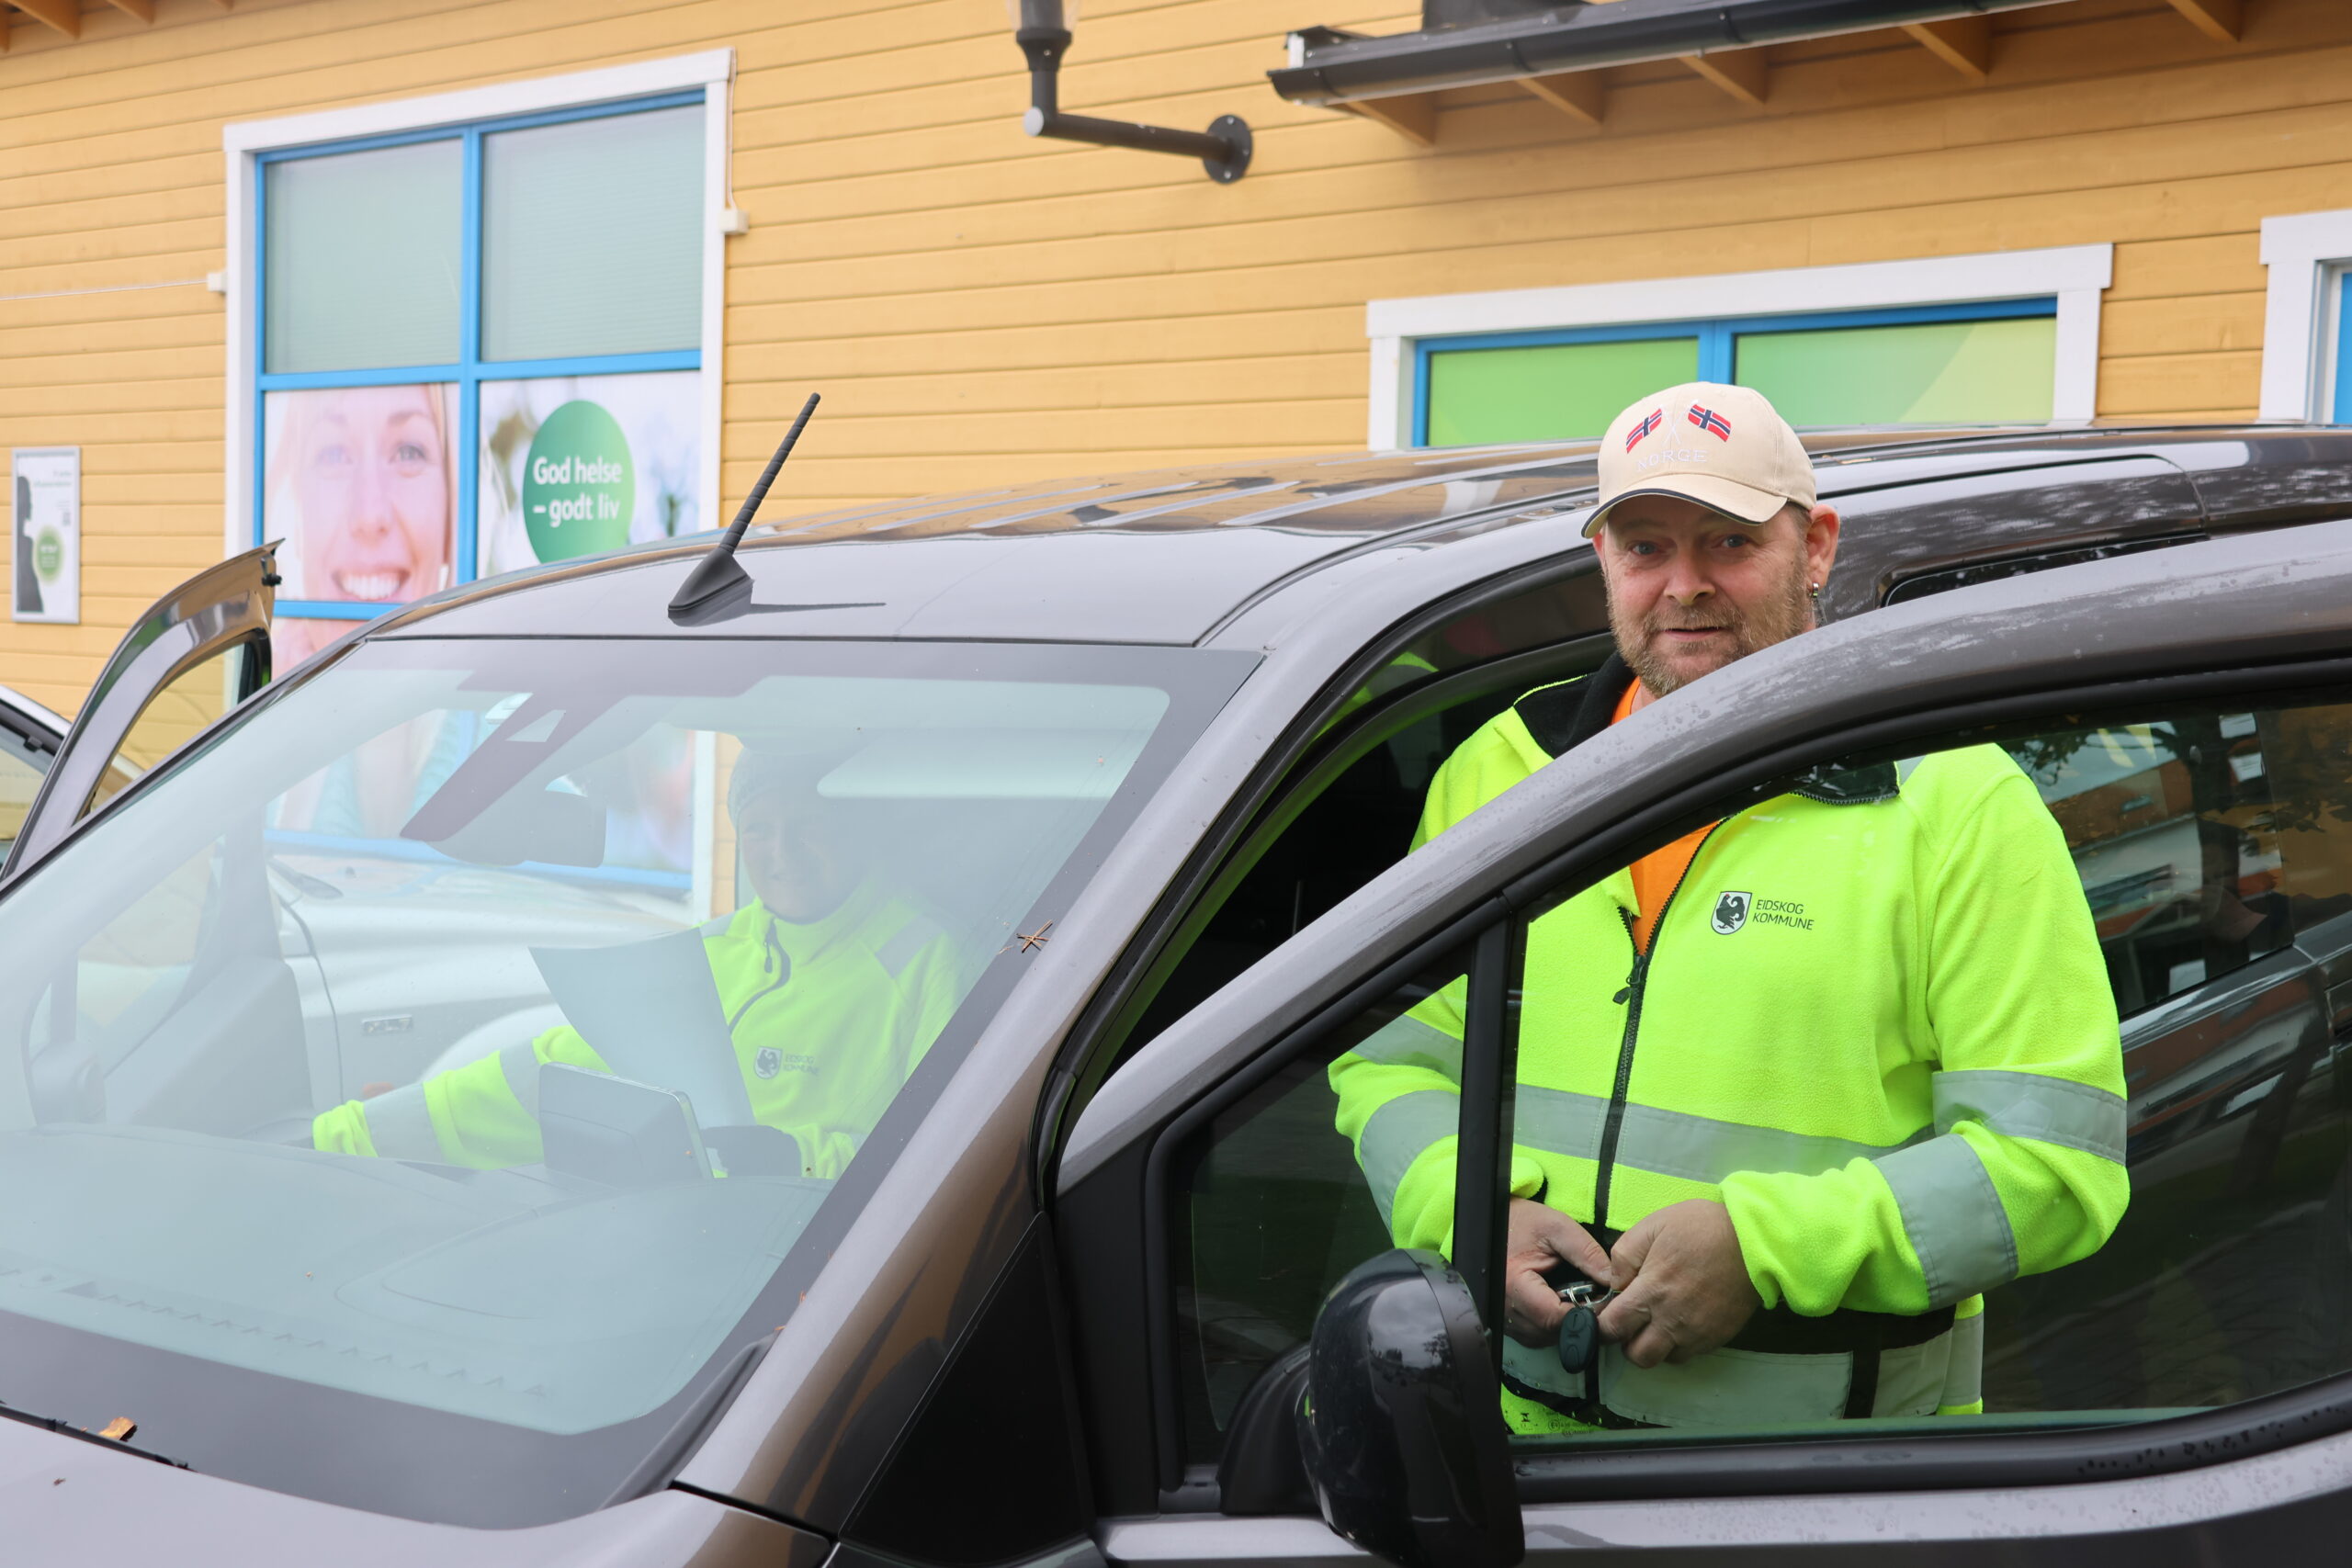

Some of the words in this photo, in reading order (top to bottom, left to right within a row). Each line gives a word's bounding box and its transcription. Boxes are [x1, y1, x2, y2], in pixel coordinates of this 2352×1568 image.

[532, 456, 571, 485] God
[574, 456, 623, 484] helse
[1635, 448, 1709, 472] NORGE
[548, 492, 594, 528] godt
[597, 492, 621, 520] liv
[1756, 899, 1804, 915] EIDSKOG
[1752, 912, 1815, 931] KOMMUNE
